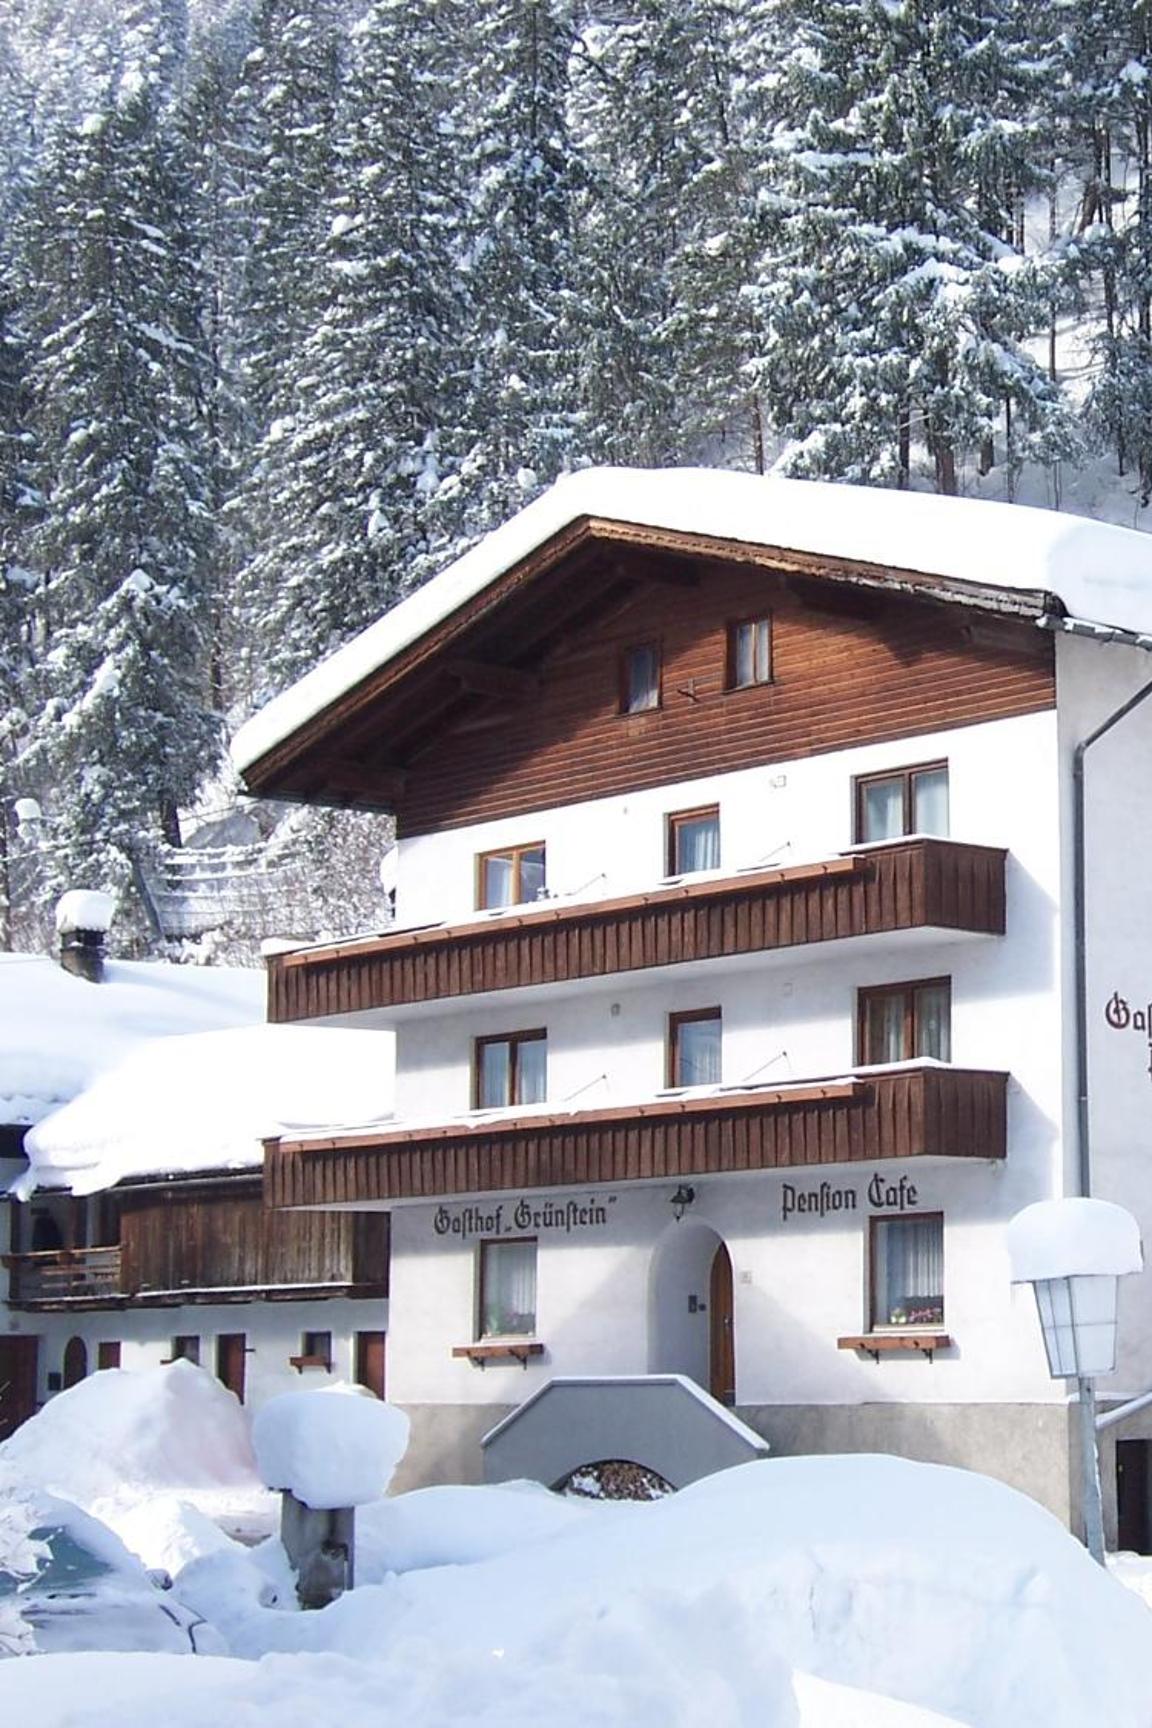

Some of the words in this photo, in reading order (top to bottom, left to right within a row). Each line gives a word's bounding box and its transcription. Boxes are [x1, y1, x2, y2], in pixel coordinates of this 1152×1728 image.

[782, 1182, 857, 1221] Pension
[867, 1172, 919, 1210] Cafe
[434, 1204, 503, 1239] Gasthof
